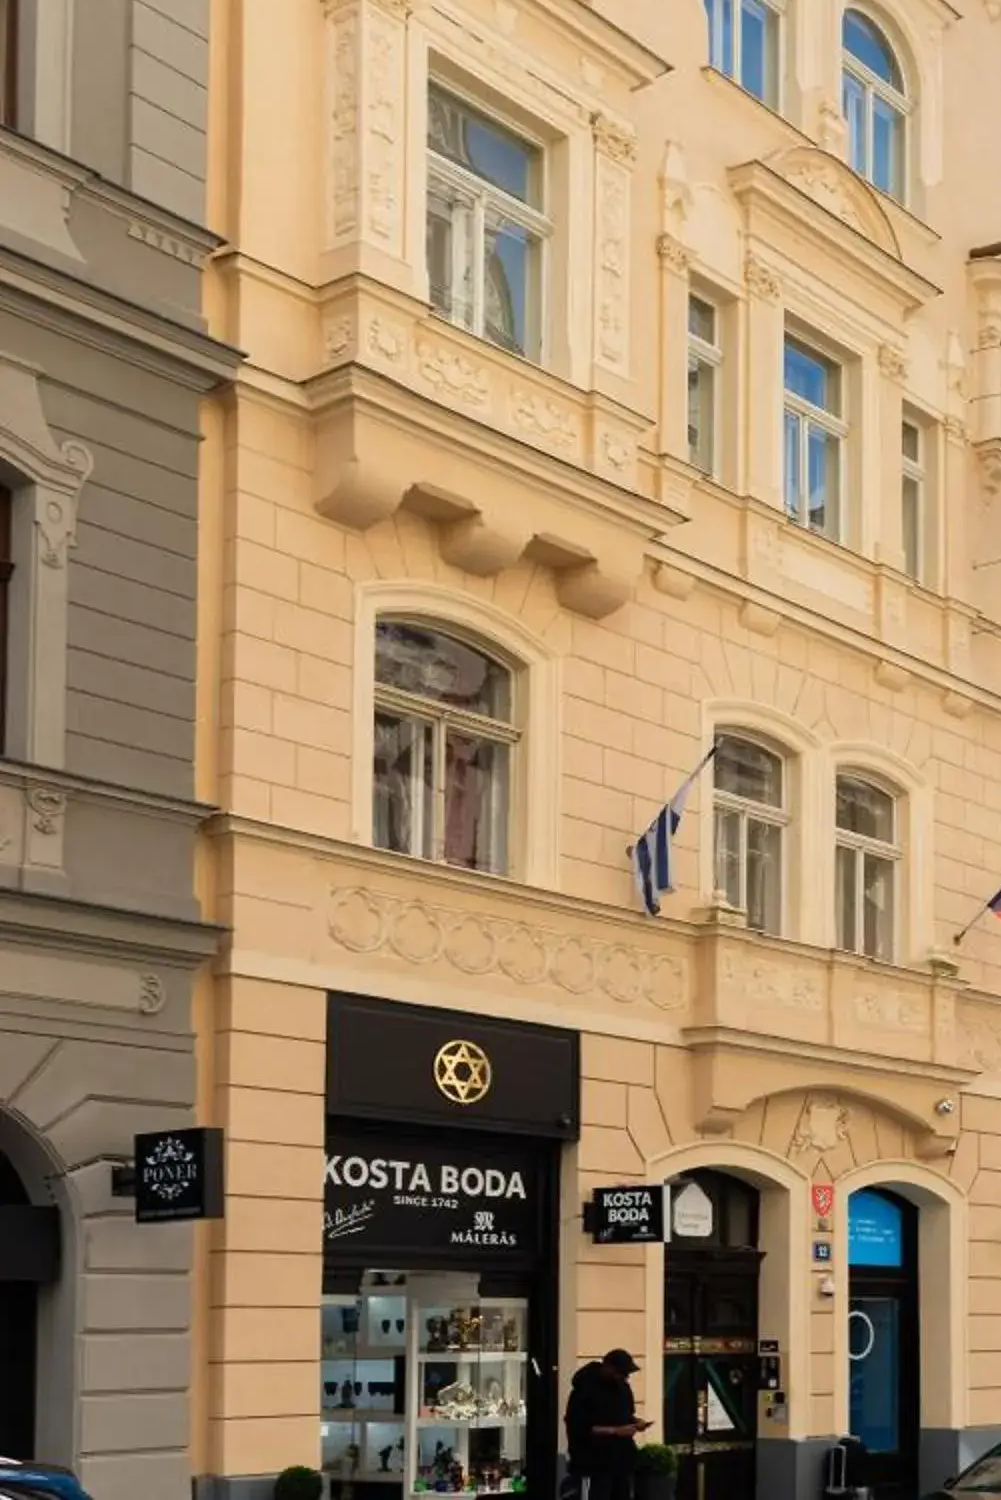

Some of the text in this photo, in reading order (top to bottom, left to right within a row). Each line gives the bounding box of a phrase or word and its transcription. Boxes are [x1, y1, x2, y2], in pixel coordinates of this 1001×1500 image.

[323, 1155, 527, 1199] KOSTA BODA
[392, 1195, 459, 1209] SINCE 1742
[603, 1191, 653, 1207] KOSTA
[607, 1207, 650, 1223] BODA
